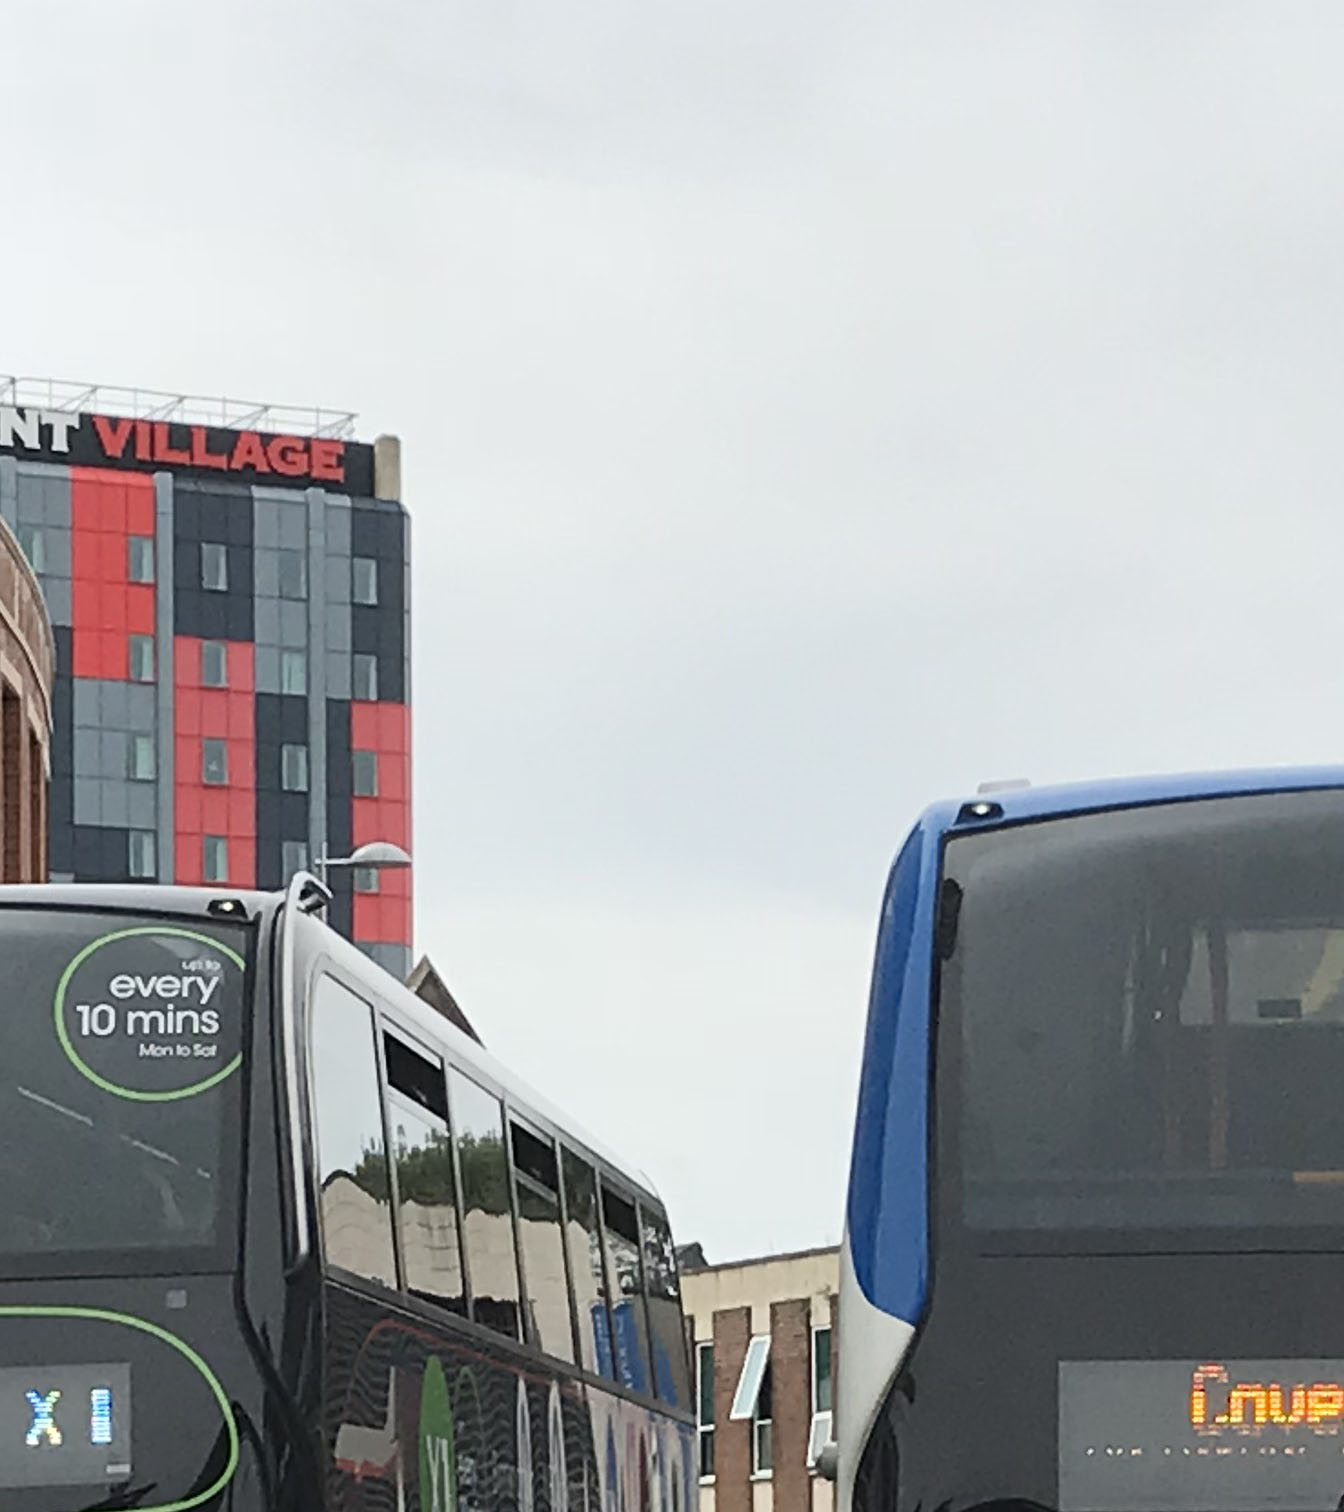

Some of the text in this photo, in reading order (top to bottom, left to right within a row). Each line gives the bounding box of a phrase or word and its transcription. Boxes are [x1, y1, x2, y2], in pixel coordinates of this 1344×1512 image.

[92, 413, 346, 483] VILLAGE
[110, 974, 219, 1005] every
[76, 1004, 220, 1036] 10 mins
